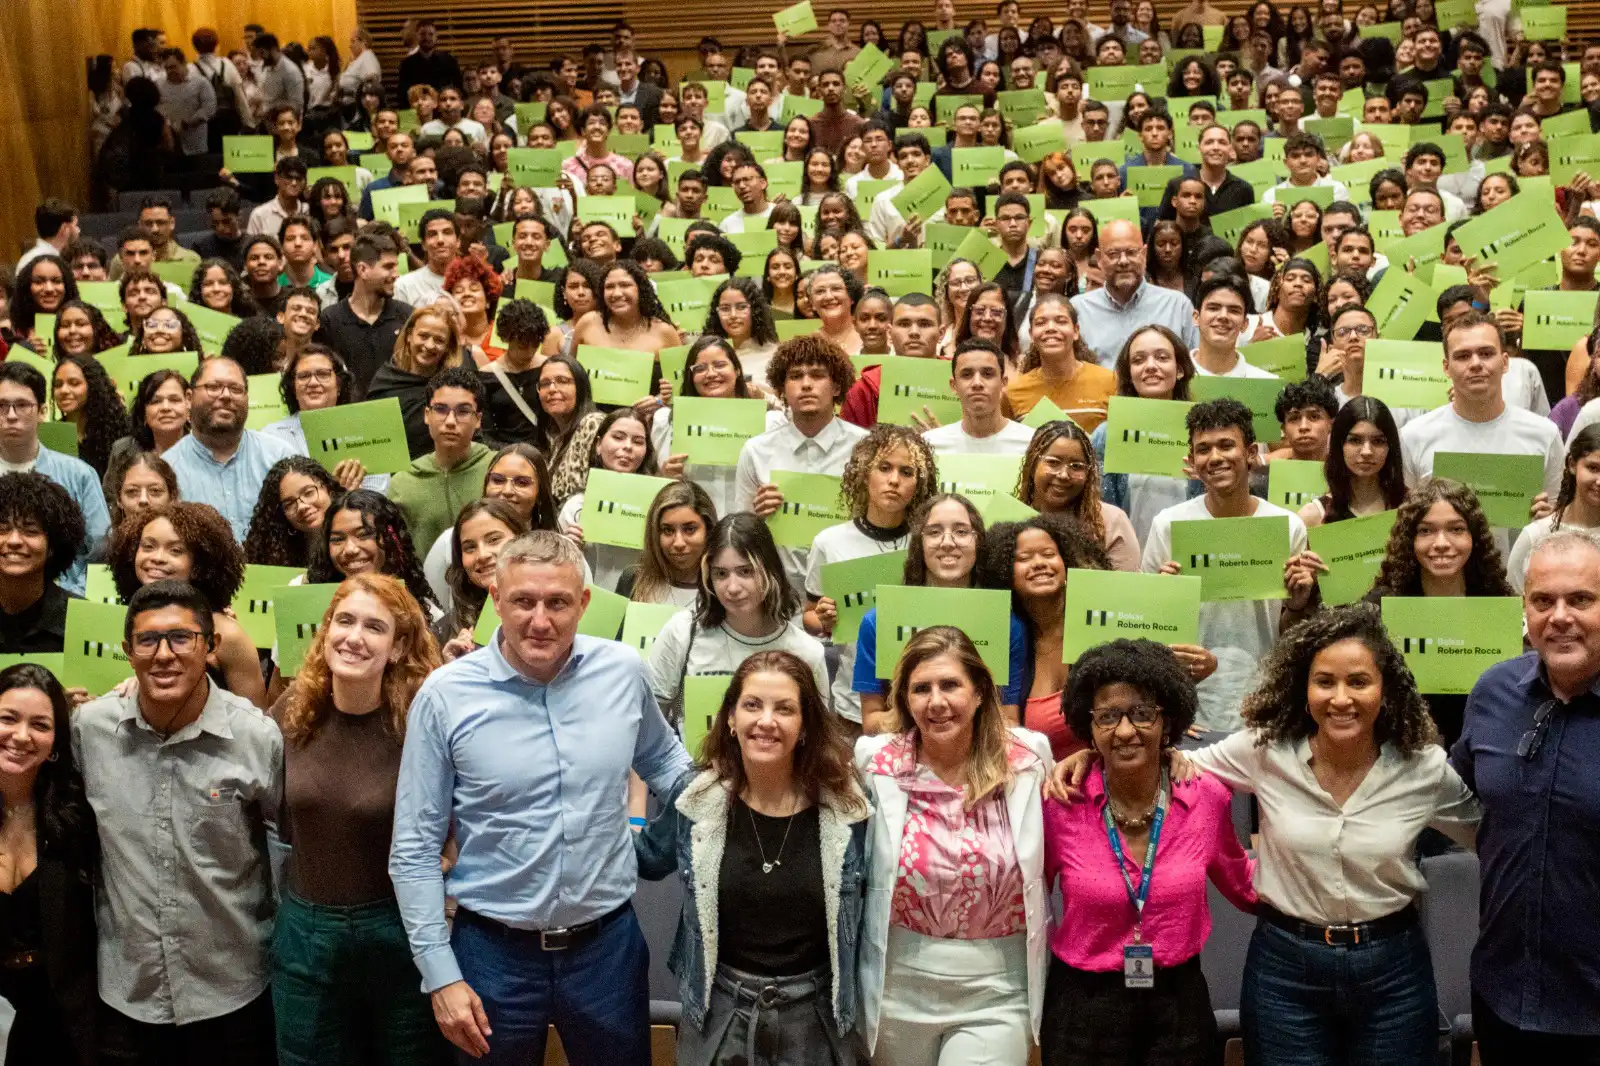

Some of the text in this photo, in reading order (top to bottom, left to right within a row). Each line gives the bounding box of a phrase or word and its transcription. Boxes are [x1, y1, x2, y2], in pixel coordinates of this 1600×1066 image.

[1504, 223, 1546, 248] Roberto Rocca
[1402, 374, 1427, 383] Roberto
[917, 392, 961, 403] Roberto Rocca
[709, 432, 734, 440] Roberto
[345, 438, 392, 450] Roberto Rocca
[1148, 438, 1175, 448] Roberto
[965, 488, 992, 497] Roberto
[1474, 489, 1526, 499] Roberto Rocca
[620, 509, 646, 519] Roberto
[807, 510, 834, 520] Roberto
[1354, 547, 1385, 559] Roberto
[1219, 558, 1274, 568] Roberto Rocca
[1331, 554, 1354, 564] Rocca
[1117, 620, 1178, 632] Roberto Rocca
[1437, 646, 1502, 656] Roberto Rocca
